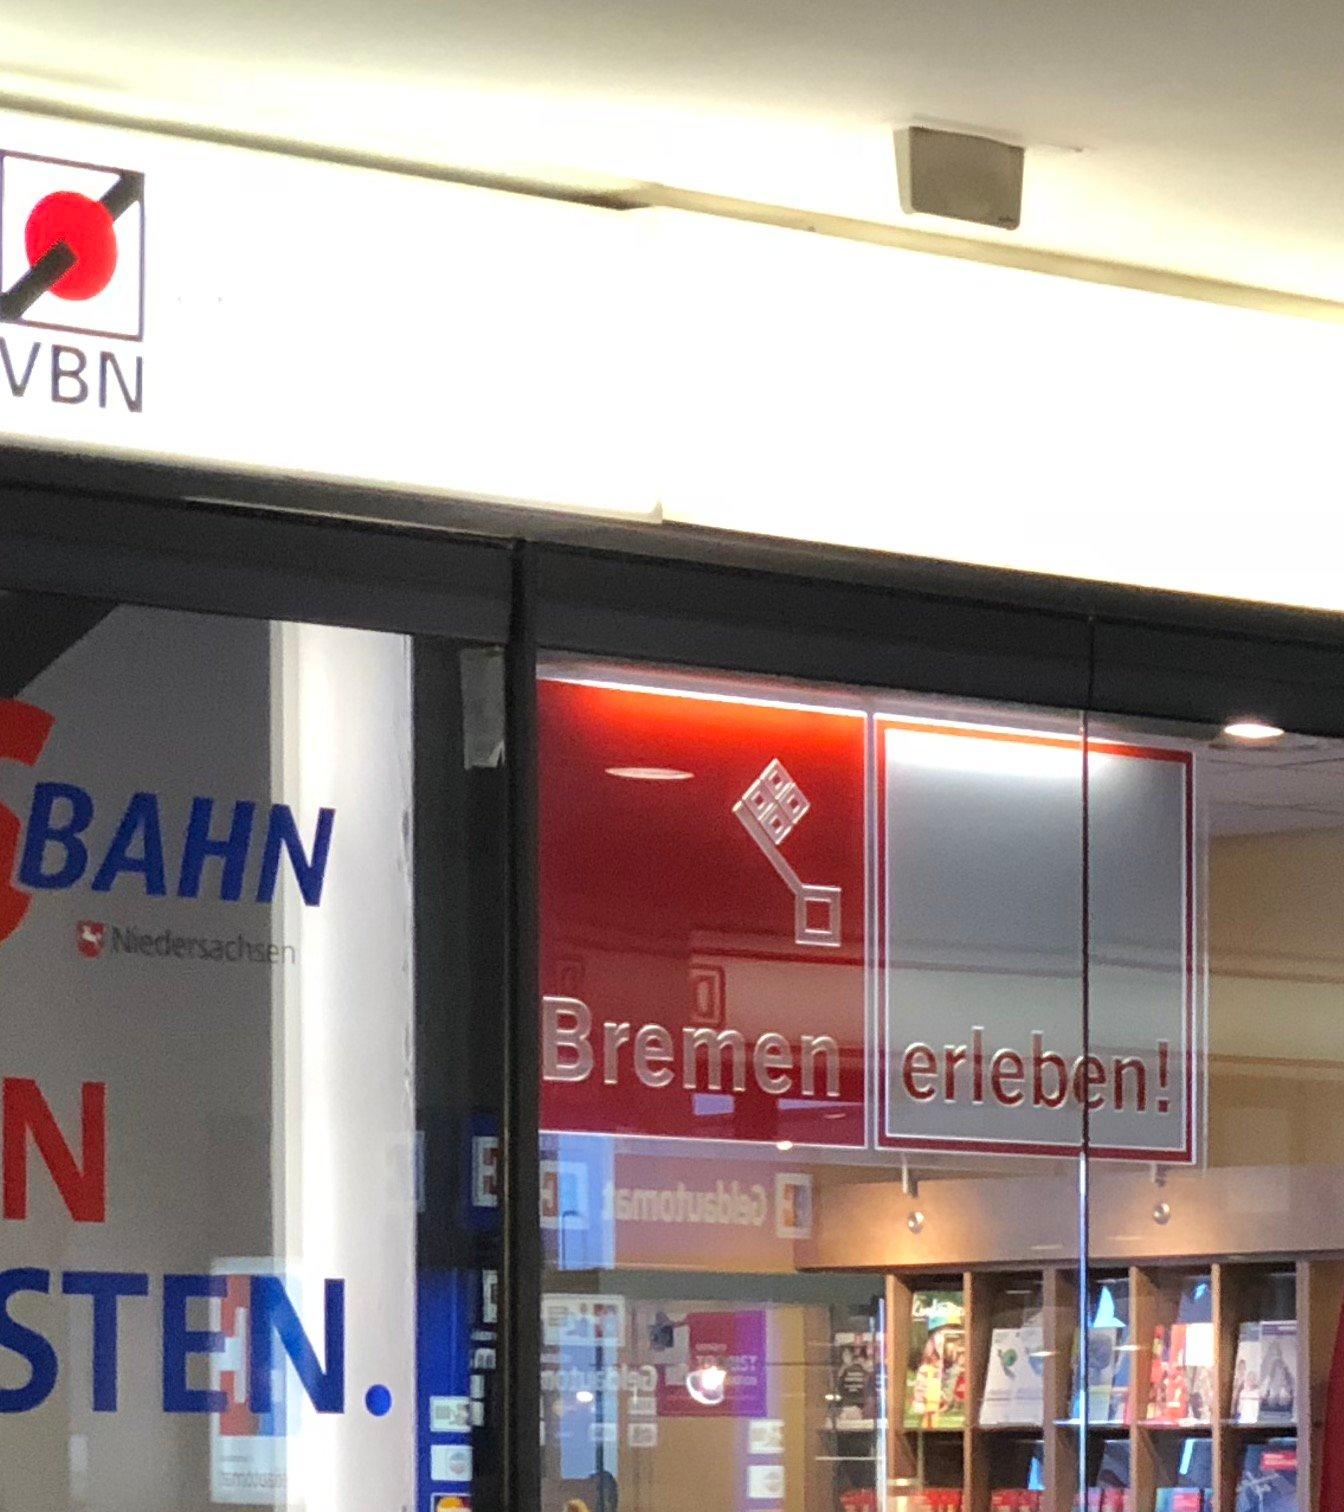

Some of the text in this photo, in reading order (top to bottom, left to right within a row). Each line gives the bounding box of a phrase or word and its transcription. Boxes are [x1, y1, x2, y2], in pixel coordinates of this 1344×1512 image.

[0, 337, 143, 413] VBN
[111, 925, 296, 965] Niedersachsen
[541, 995, 1172, 1114] Bremen erleben!
